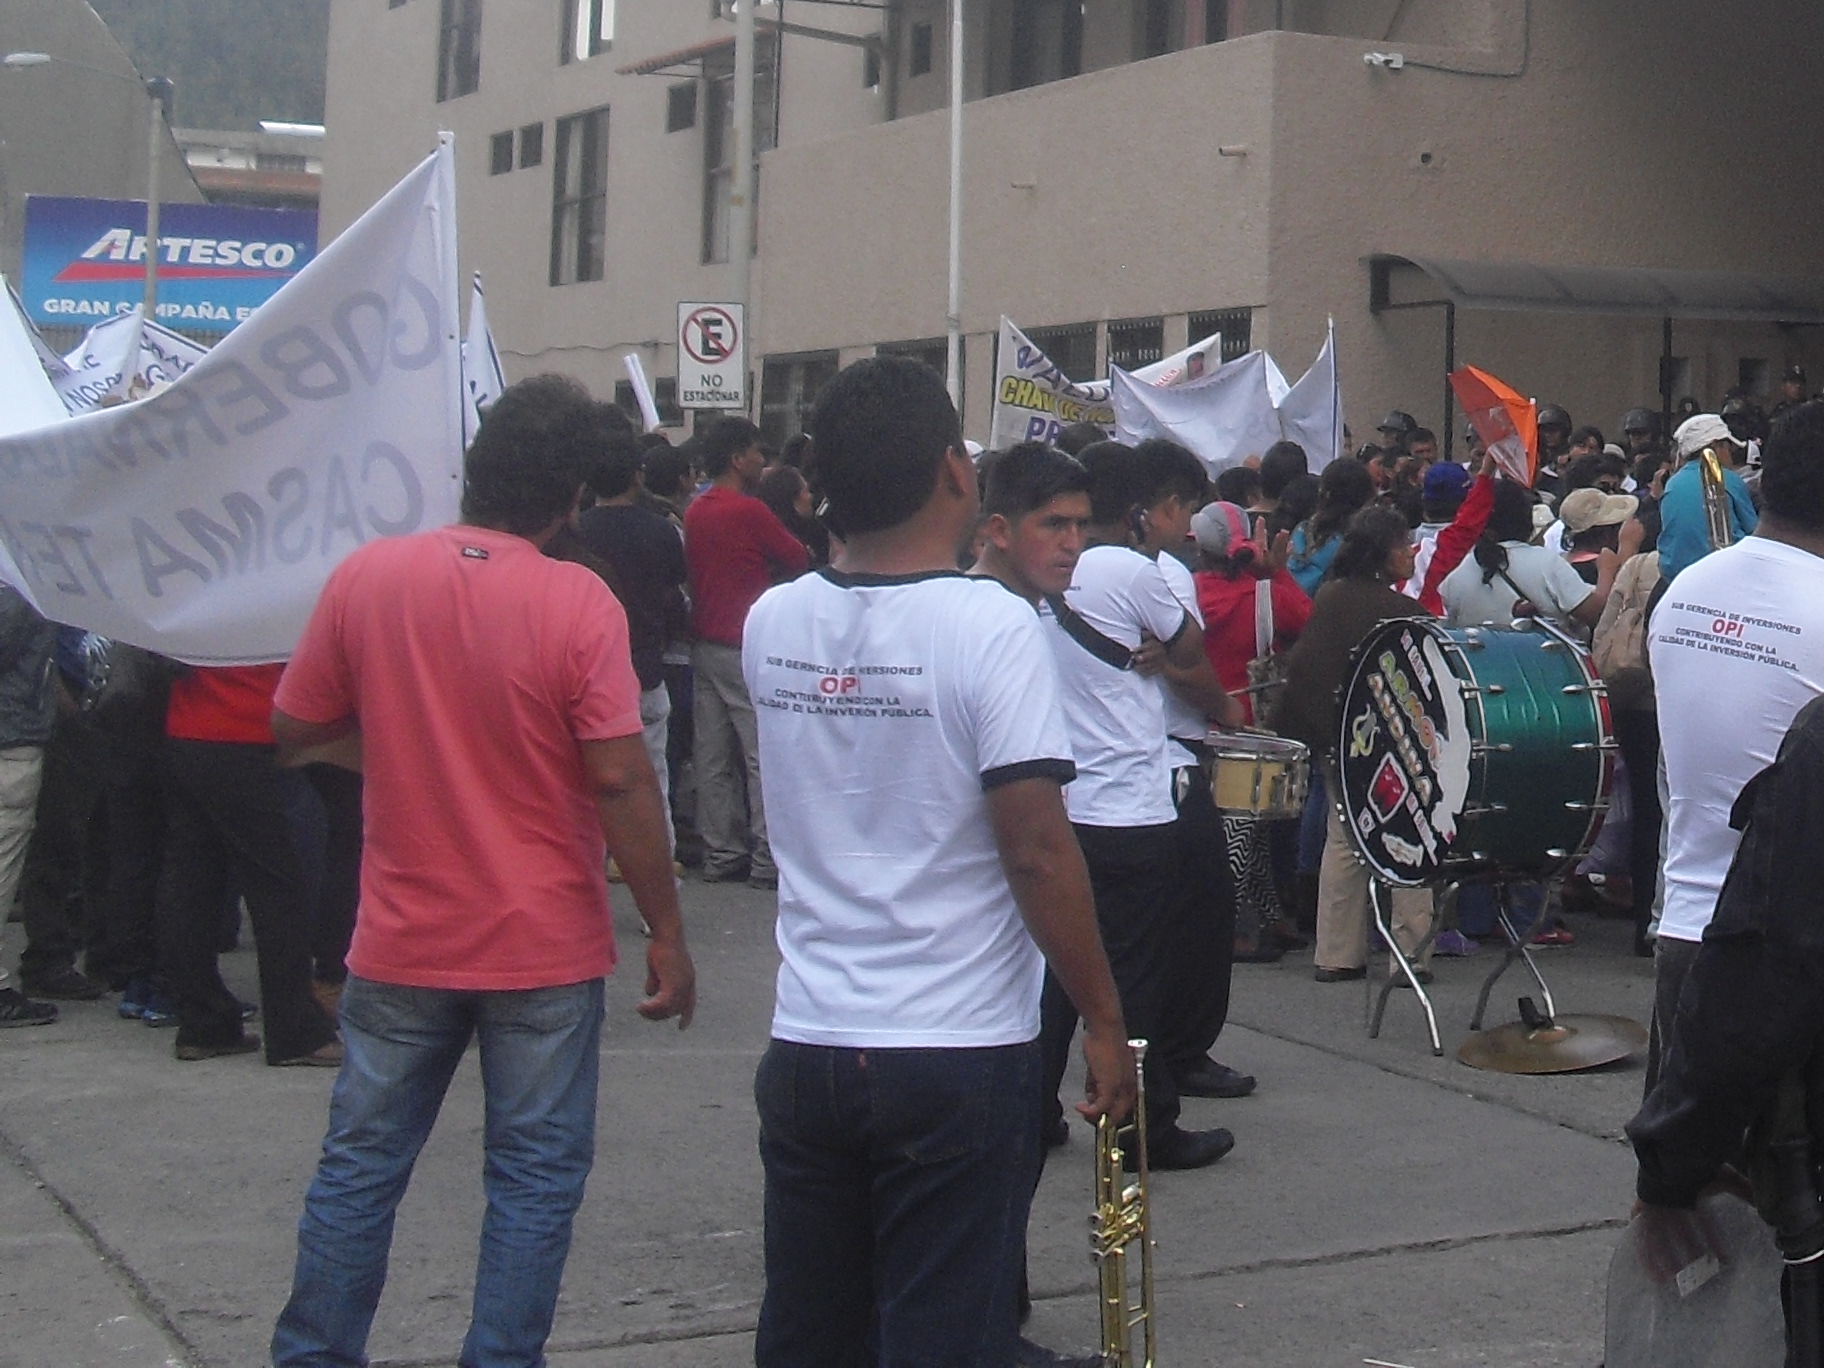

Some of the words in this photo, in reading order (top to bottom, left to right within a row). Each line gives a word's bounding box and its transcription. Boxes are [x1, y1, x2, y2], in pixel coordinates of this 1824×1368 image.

[43, 299, 110, 317] GRAN
[701, 374, 723, 387] NO
[683, 390, 740, 402] ESTACIONAR
[1686, 604, 1726, 618] GERENCIA
[1728, 613, 1740, 621] DE
[1741, 616, 1802, 635] INVERSIONES
[1711, 618, 1744, 638] OPI
[1675, 627, 1743, 648] CONTRIBUYENDO
[1744, 641, 1763, 653] CON
[1765, 645, 1777, 655] LA
[1685, 639, 1696, 648] DE
[1697, 642, 1708, 651] LA
[887, 696, 901, 705] LA
[807, 705, 822, 714] LA
